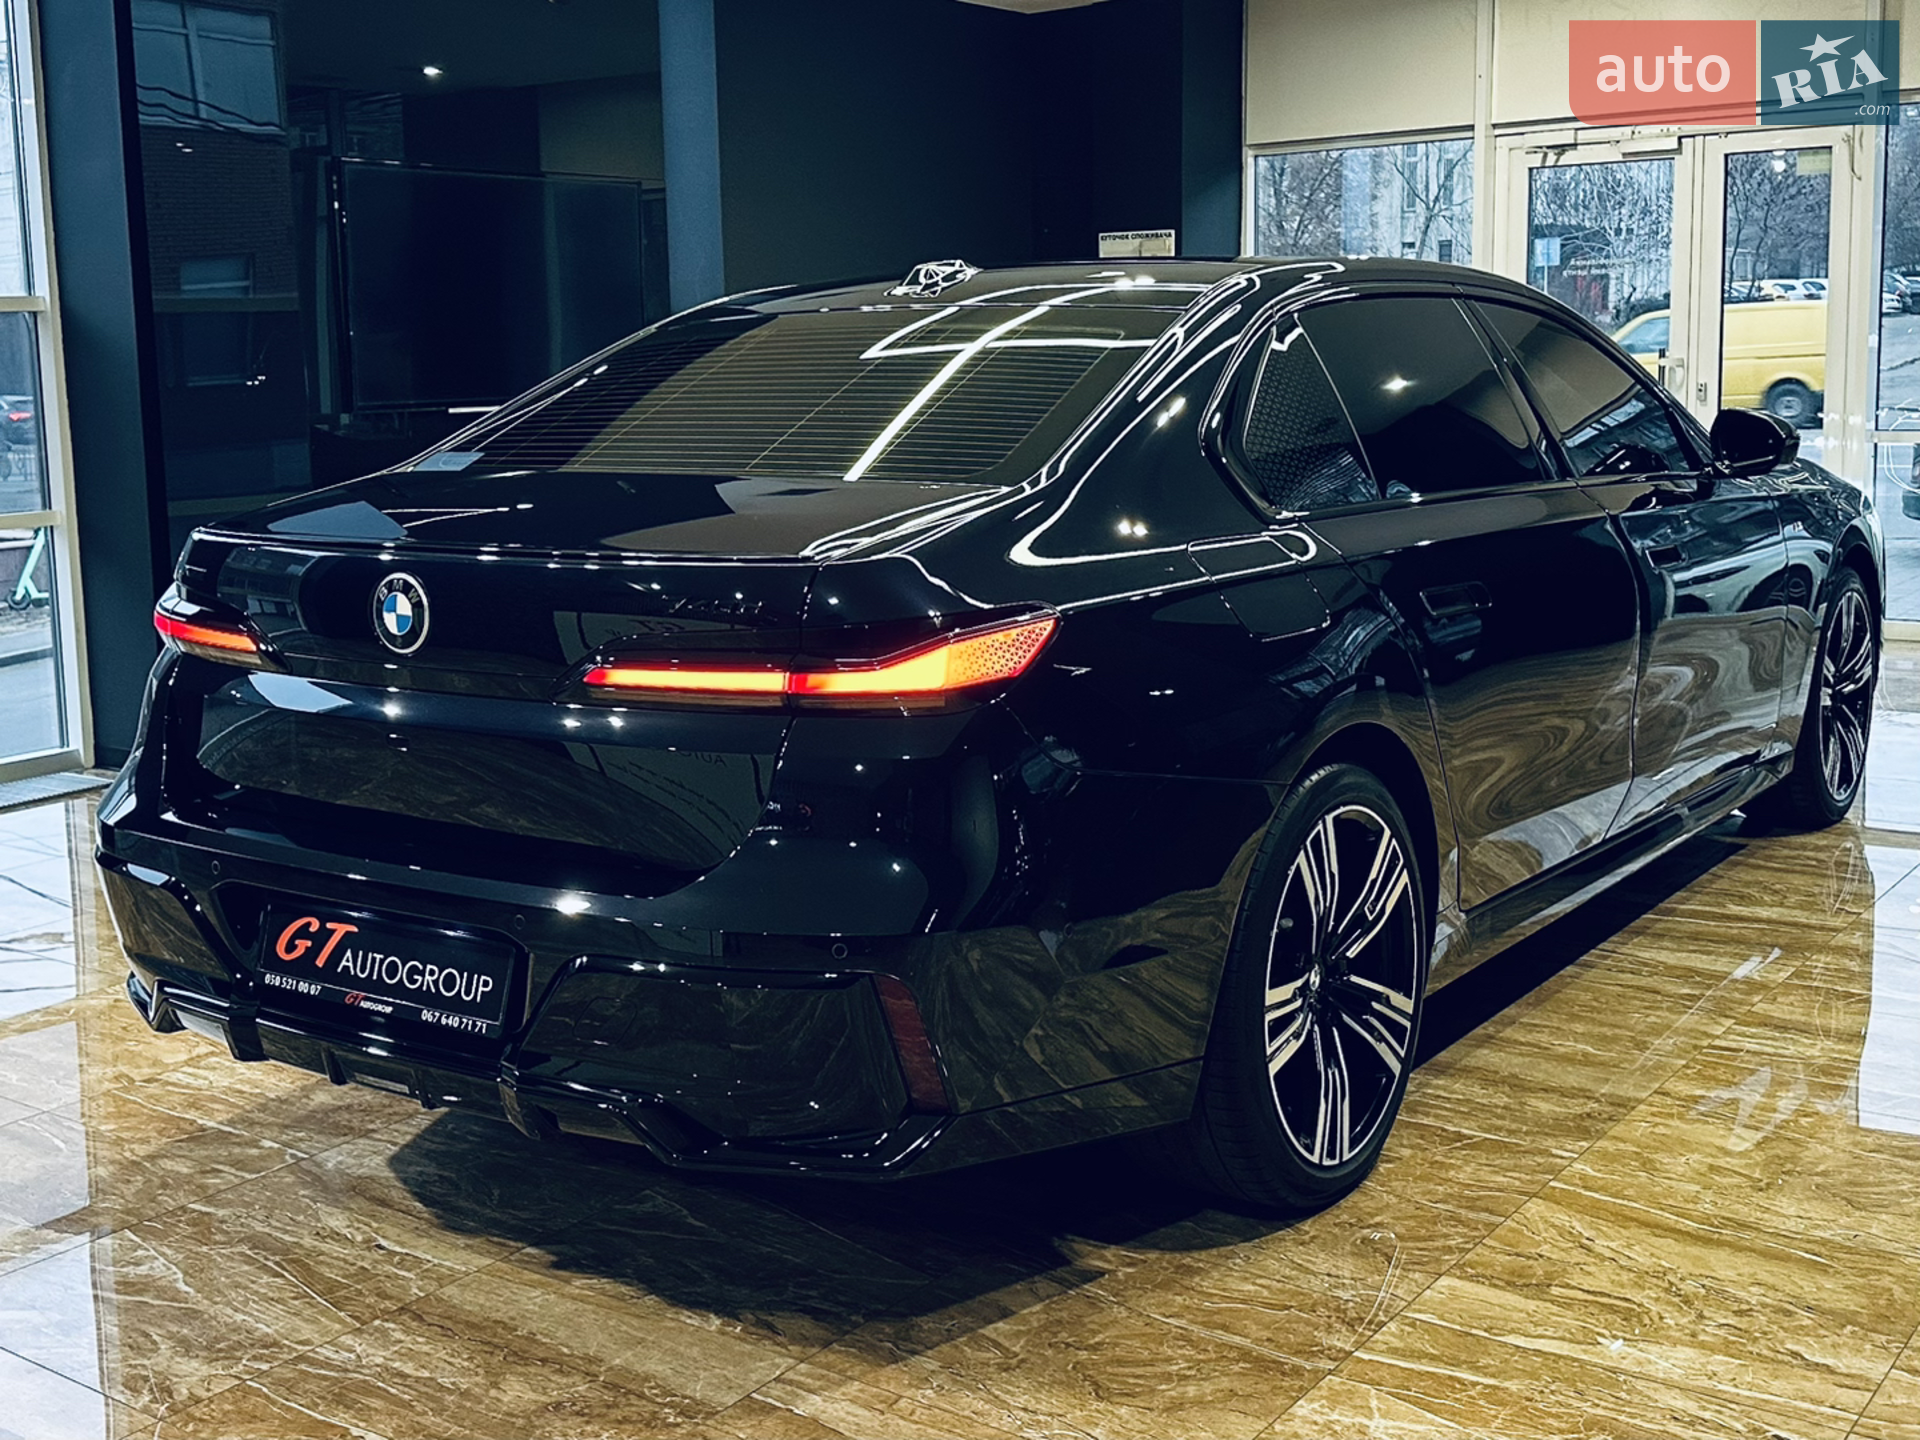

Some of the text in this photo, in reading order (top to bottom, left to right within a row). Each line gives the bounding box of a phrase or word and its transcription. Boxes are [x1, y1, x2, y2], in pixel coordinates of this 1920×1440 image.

[378, 579, 421, 604] BMW
[275, 916, 494, 1003] GT AUTOGROUP
[281, 977, 297, 990] 521
[309, 984, 322, 996] 07
[421, 1009, 487, 1035] 067 640 71 71
